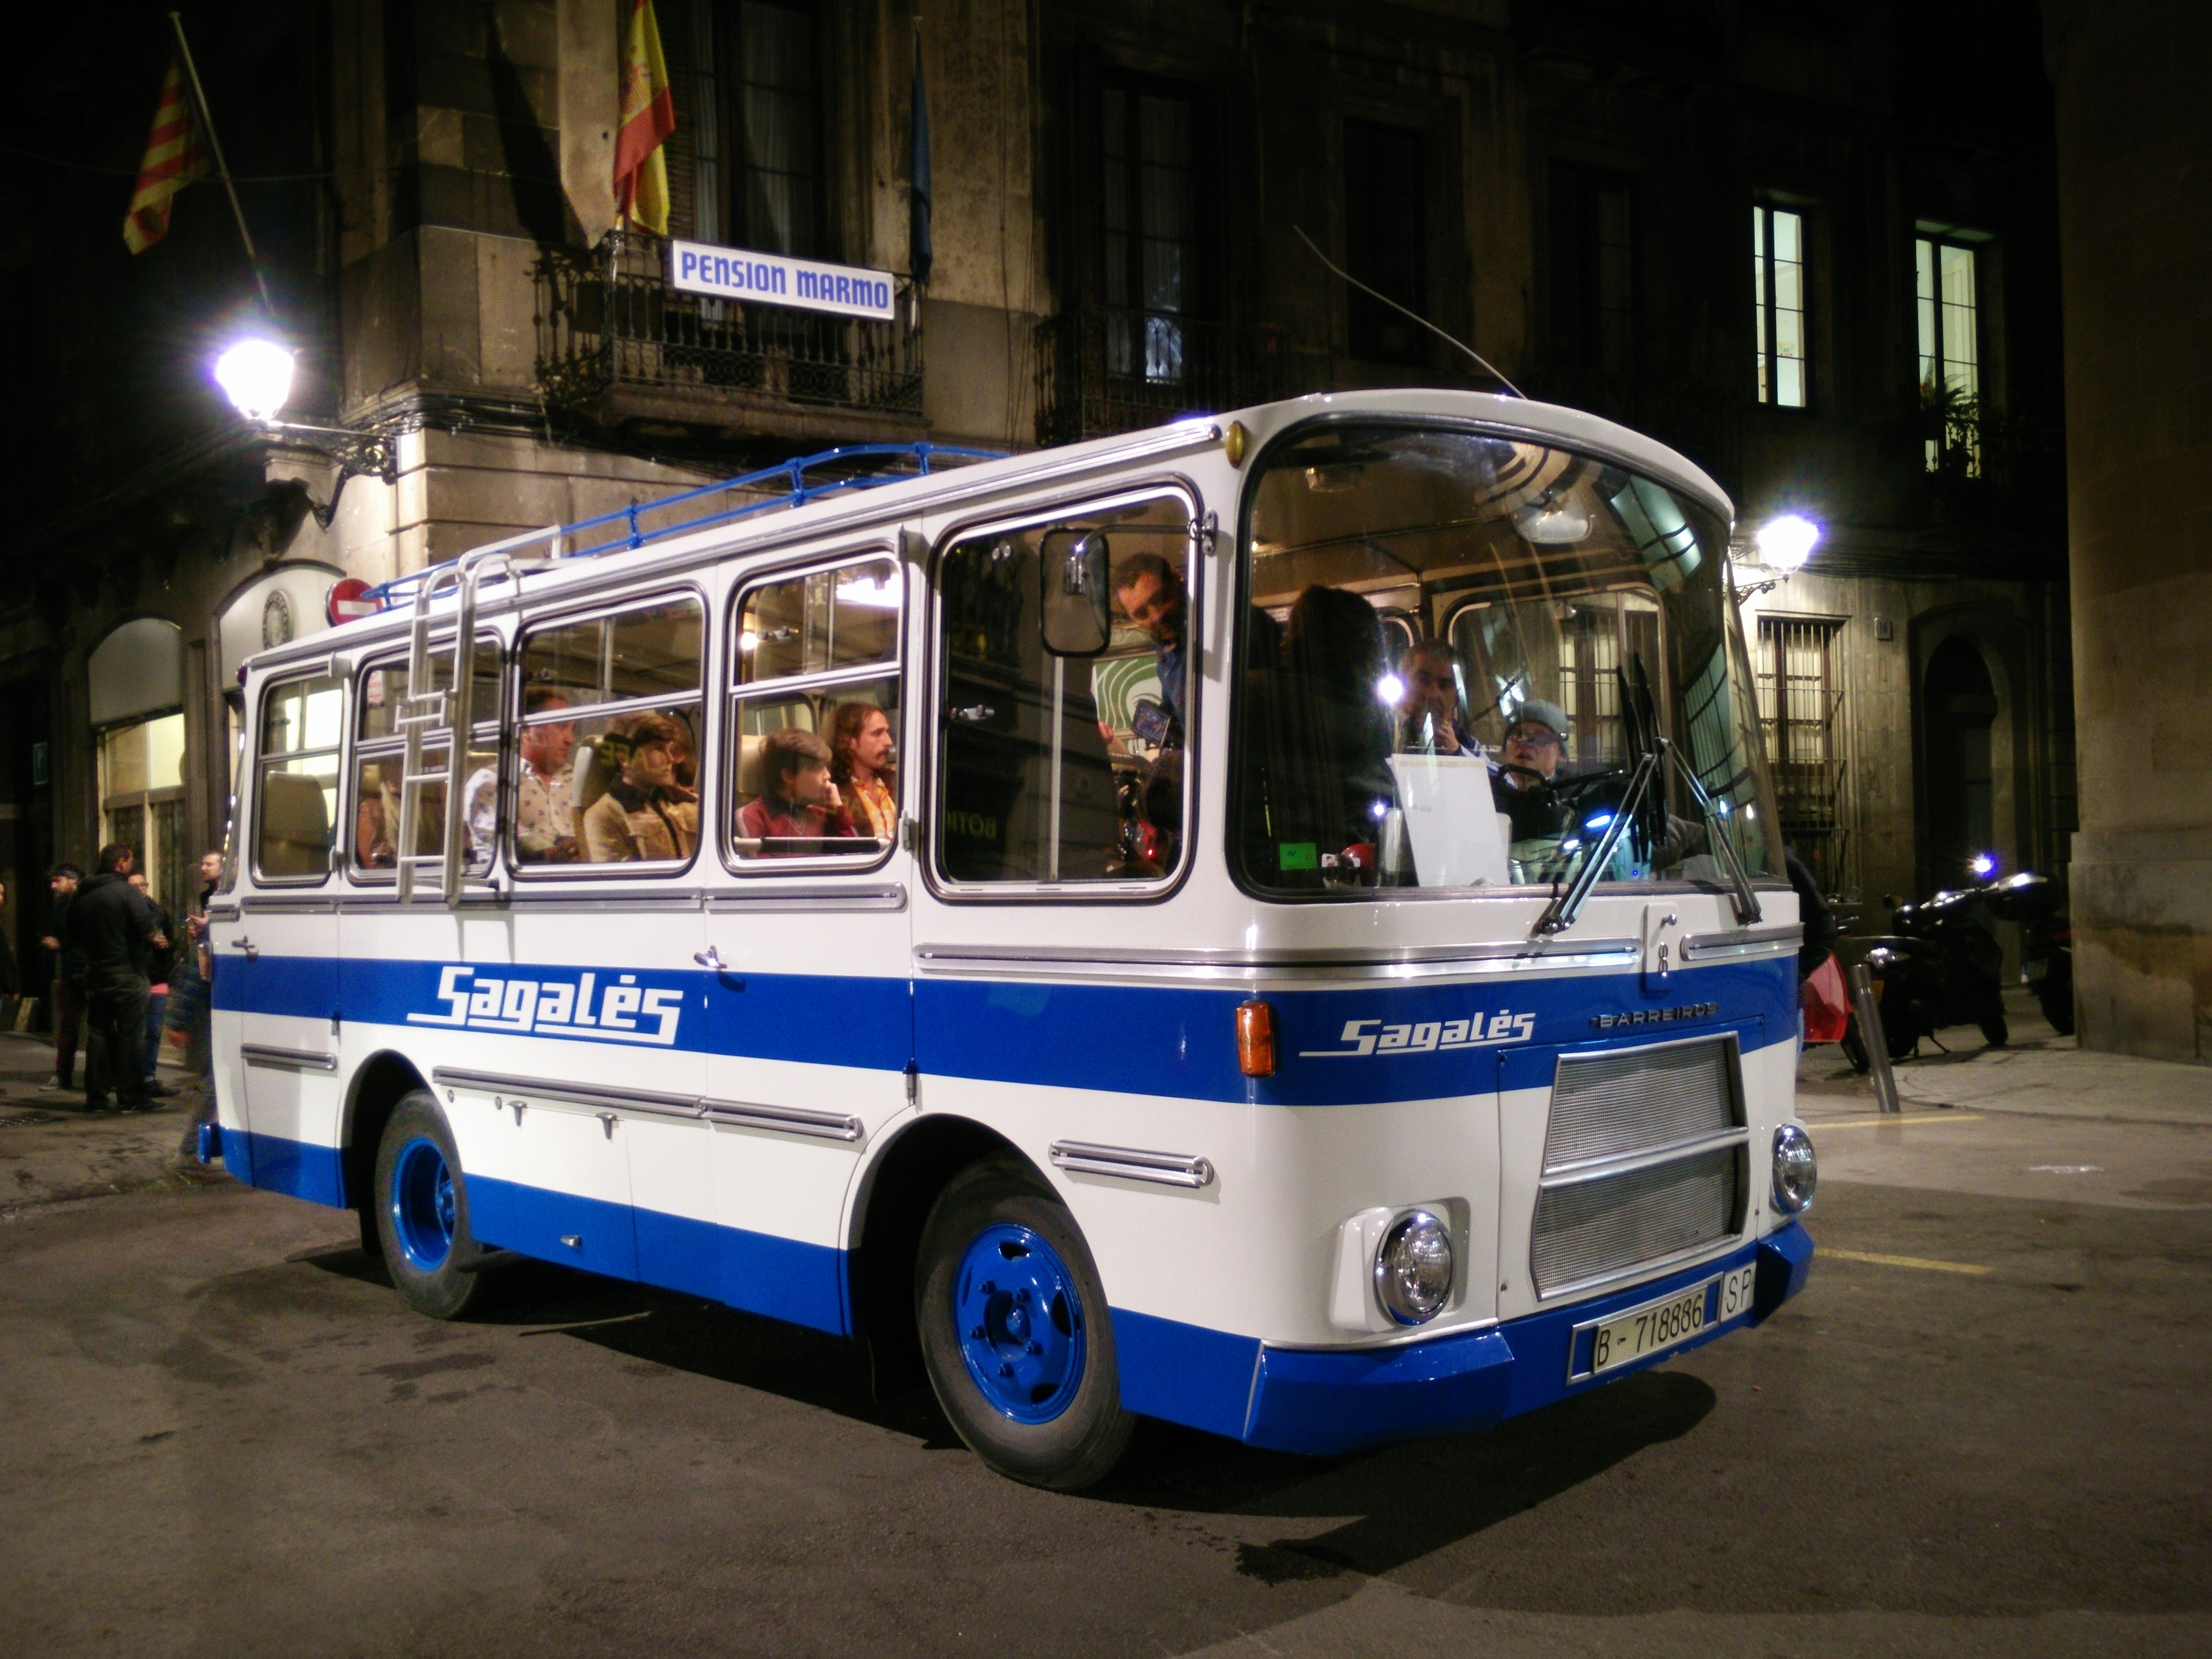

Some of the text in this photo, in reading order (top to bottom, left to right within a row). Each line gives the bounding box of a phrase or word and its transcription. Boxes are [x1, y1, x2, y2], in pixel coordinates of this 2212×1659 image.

[681, 250, 889, 309] PENSION MARMO
[406, 965, 684, 1045] Sagalés
[1599, 1002, 1719, 1028] BARREIROS
[1298, 1009, 1536, 1056] Sagalés
